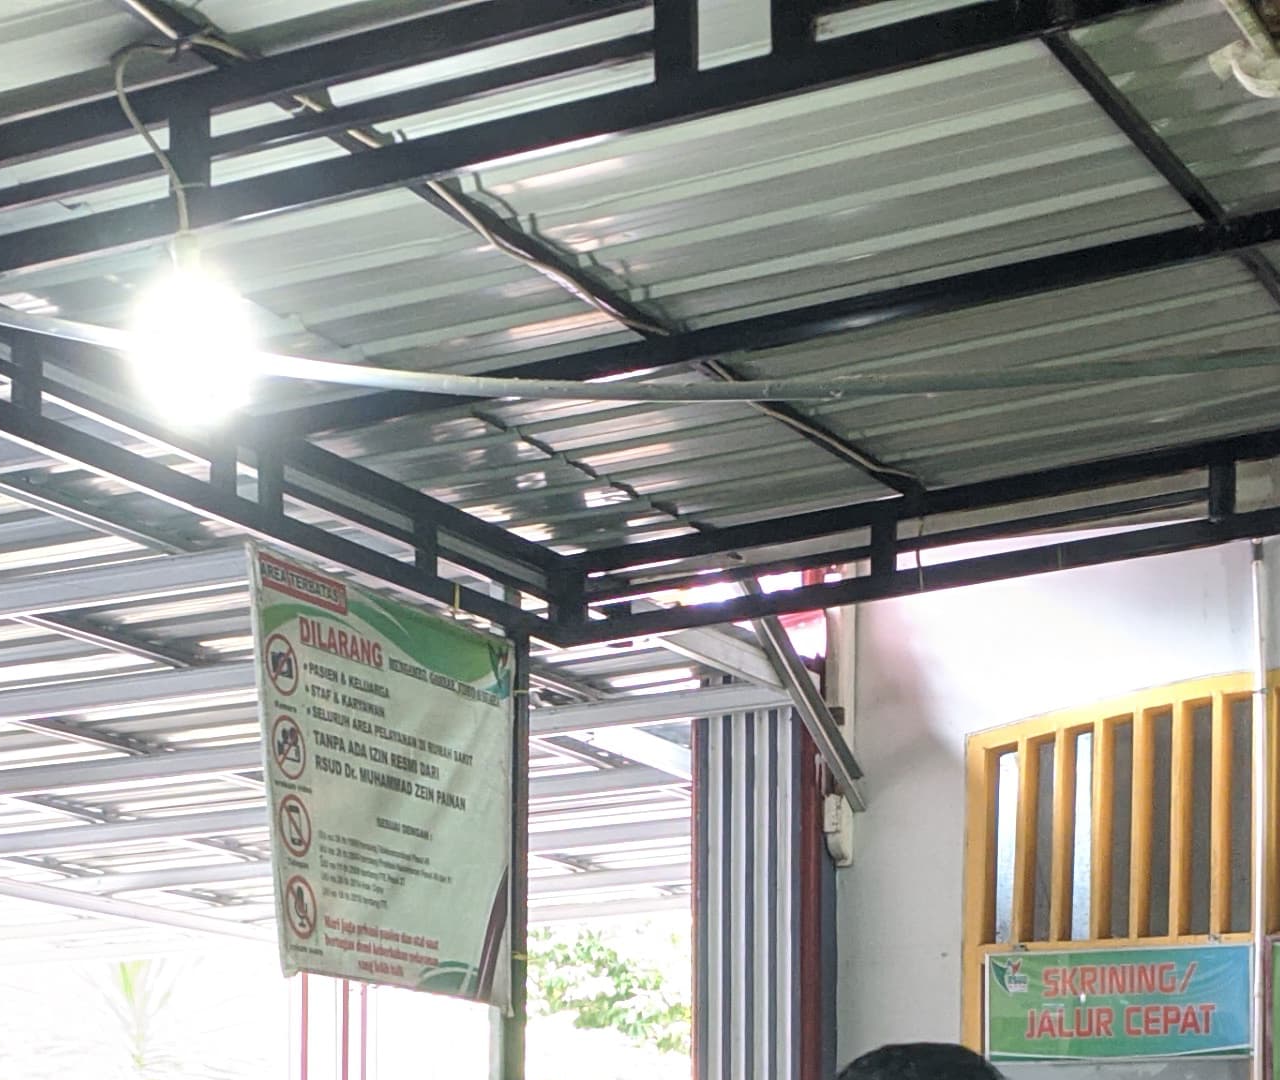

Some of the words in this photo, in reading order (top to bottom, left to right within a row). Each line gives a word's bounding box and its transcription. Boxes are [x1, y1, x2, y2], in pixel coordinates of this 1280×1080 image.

[300, 616, 384, 668] DILARANG
[309, 662, 338, 683] PASIEN
[349, 674, 390, 699] KELUARGA
[312, 684, 331, 702] STAF
[342, 693, 385, 718] KARYAWAN
[312, 705, 350, 729] SELURUH
[352, 713, 372, 735] AREA
[313, 730, 345, 753] TANPA
[348, 740, 367, 759] ADA
[369, 746, 388, 765] IZIN
[391, 753, 417, 775] RESMI
[420, 761, 440, 780] DARI
[315, 755, 343, 776] RSUD
[360, 766, 413, 796] MUHAMMAD
[414, 783, 435, 804] ZEIN
[436, 790, 467, 812] PAINAN
[1041, 961, 1198, 998] SKRINING/
[1025, 1007, 1114, 1040] JALUR
[1124, 1004, 1216, 1036] CEPAT
